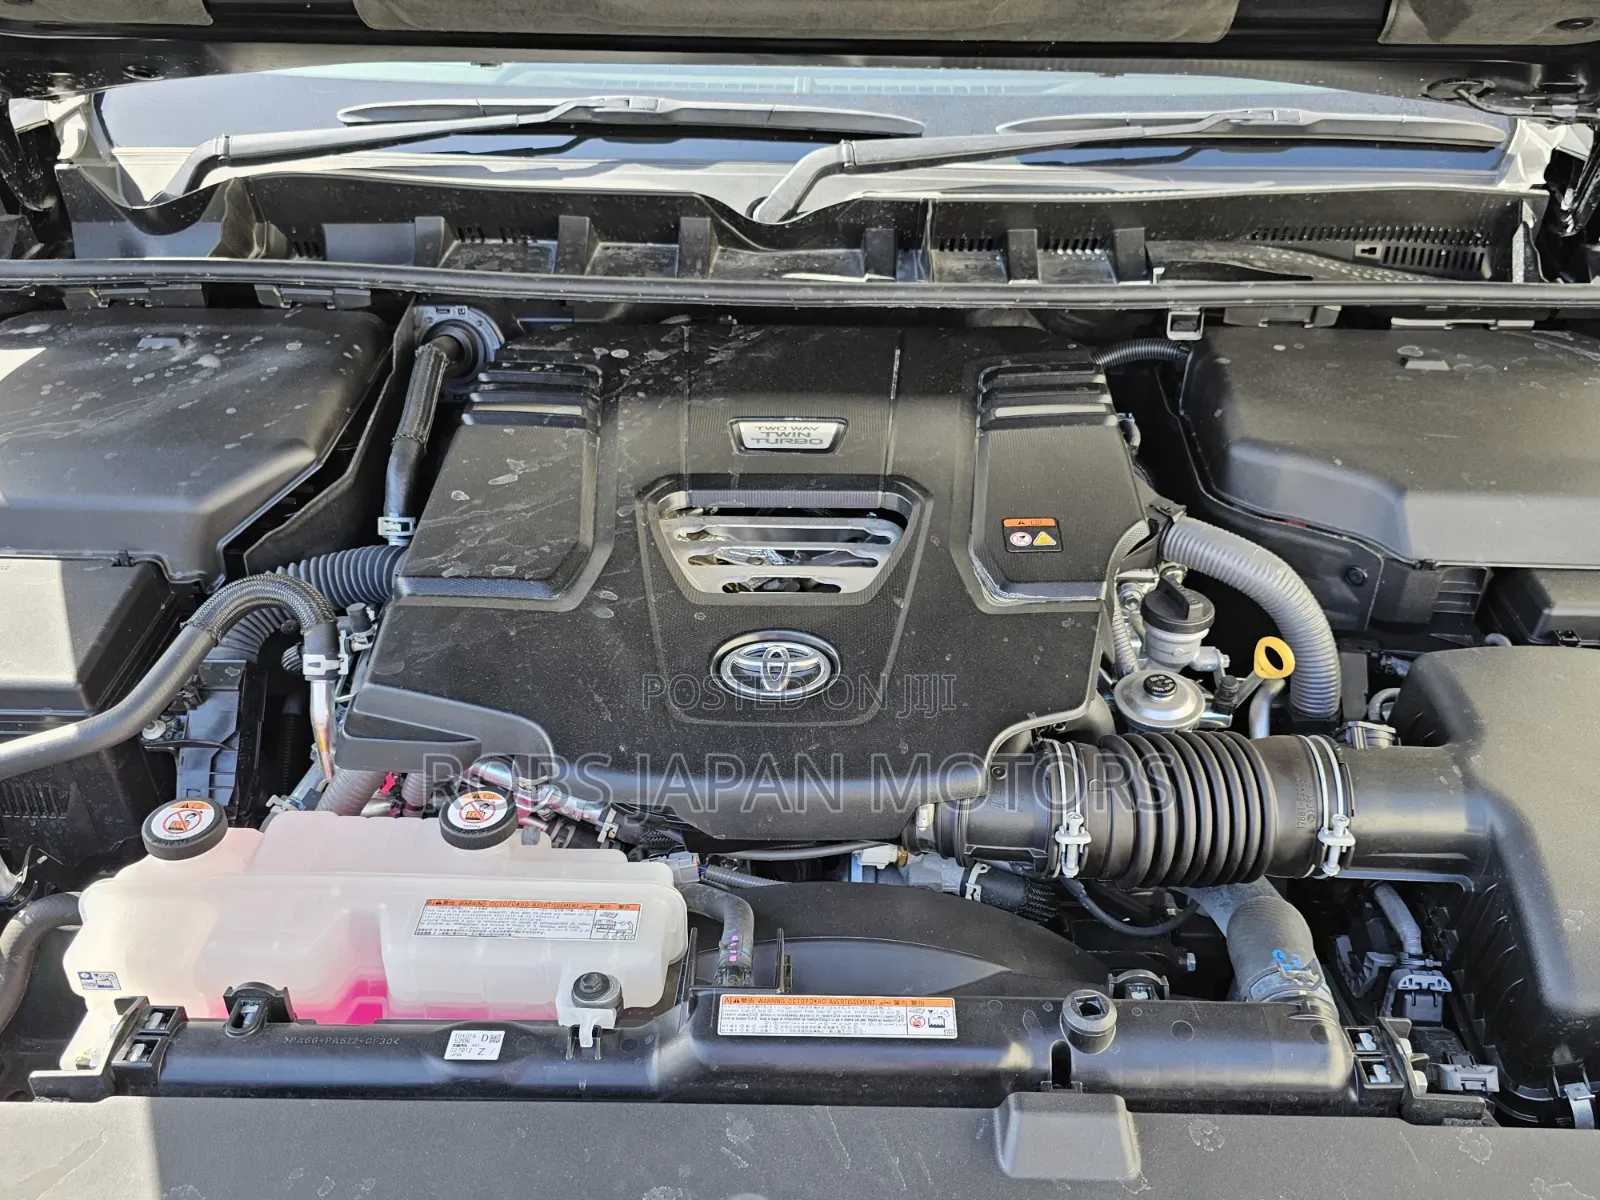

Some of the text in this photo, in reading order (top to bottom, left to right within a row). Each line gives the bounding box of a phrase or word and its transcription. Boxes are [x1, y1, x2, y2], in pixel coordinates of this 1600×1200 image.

[829, 998, 875, 1006] AVERTISSEMENT
[481, 1033, 489, 1042] D
[477, 1047, 486, 1056] Z
